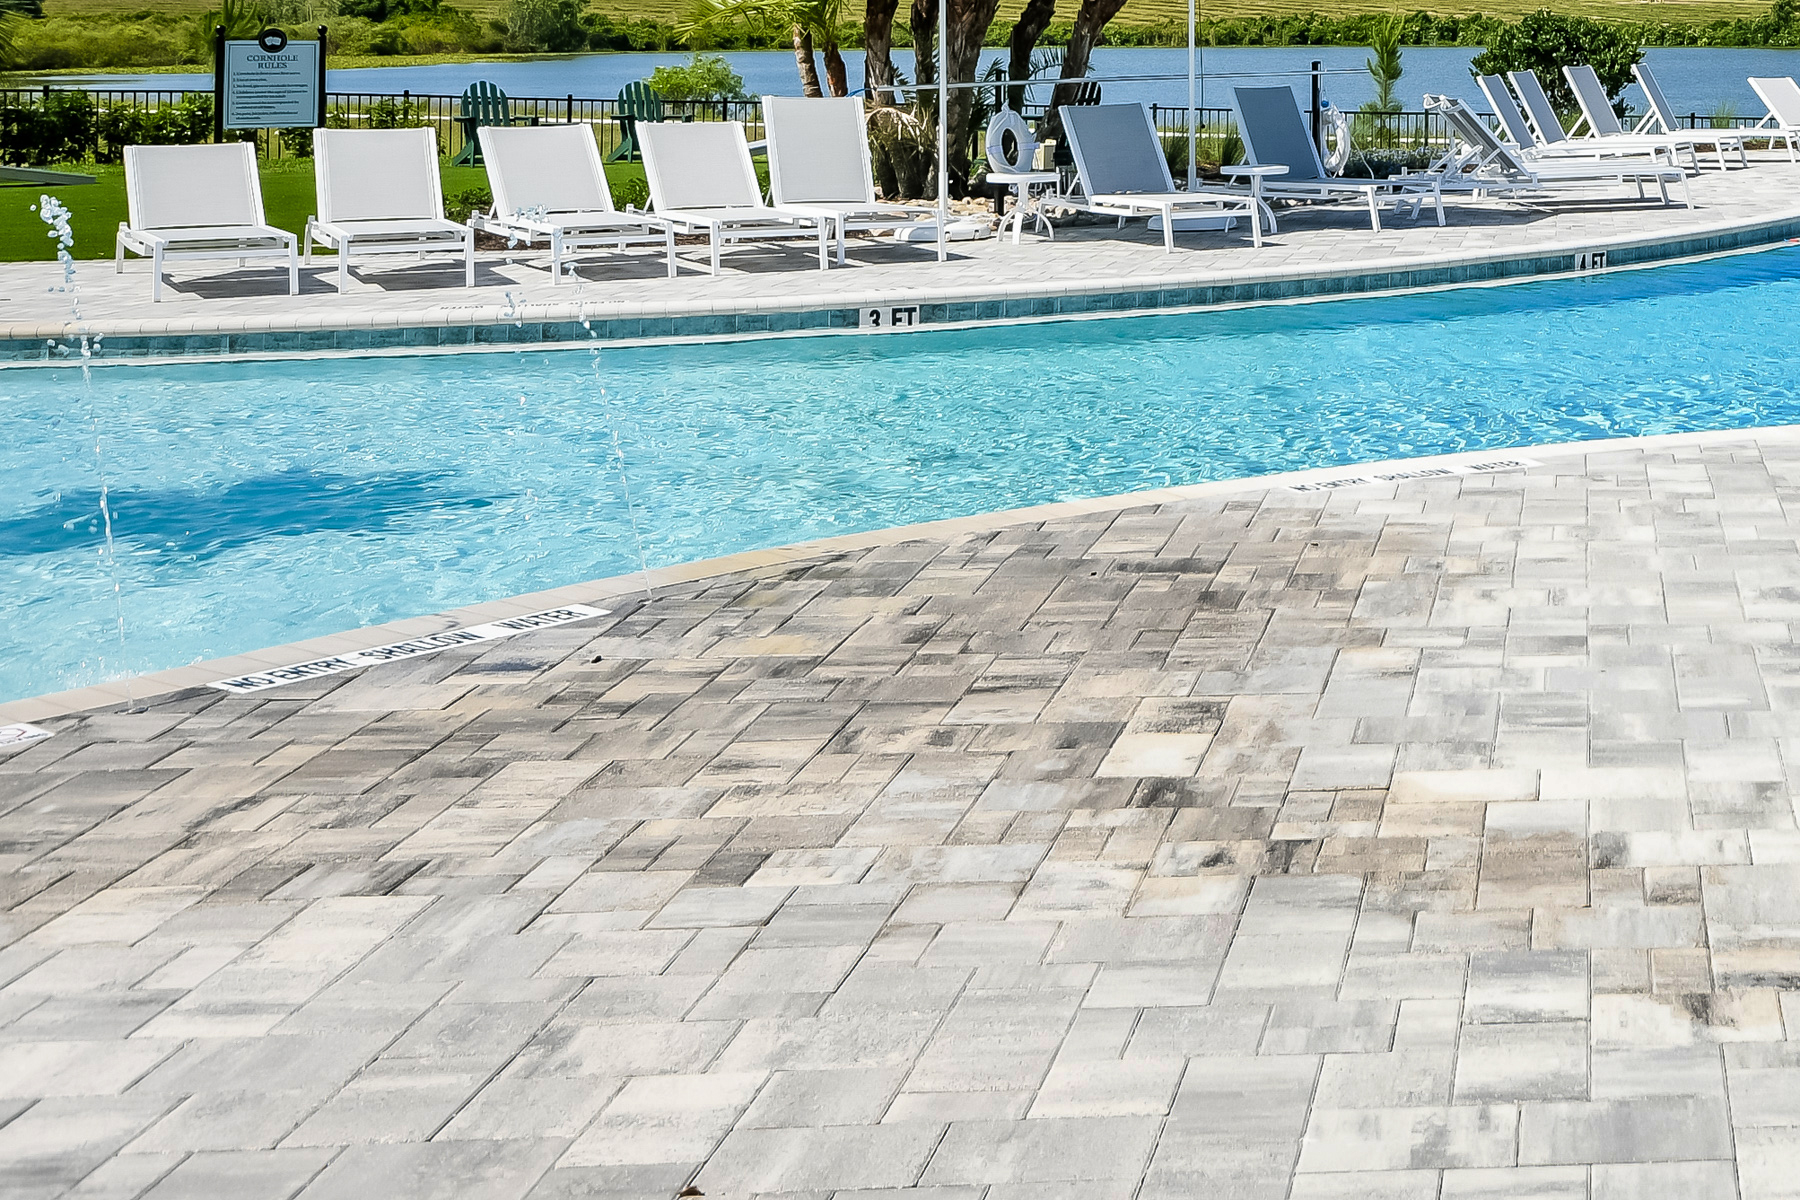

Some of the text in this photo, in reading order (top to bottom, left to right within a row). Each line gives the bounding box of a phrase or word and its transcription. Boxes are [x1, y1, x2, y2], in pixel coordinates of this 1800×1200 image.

[246, 54, 299, 62] CORNHOLE
[1579, 251, 1605, 271] 4 FT
[868, 306, 918, 327] 3 FT
[1315, 478, 1371, 489] ENTRY
[1373, 468, 1454, 481] SHALLOW
[1464, 460, 1528, 471] WATER
[221, 608, 589, 690] NO ENTRY SHALLOW WATER
